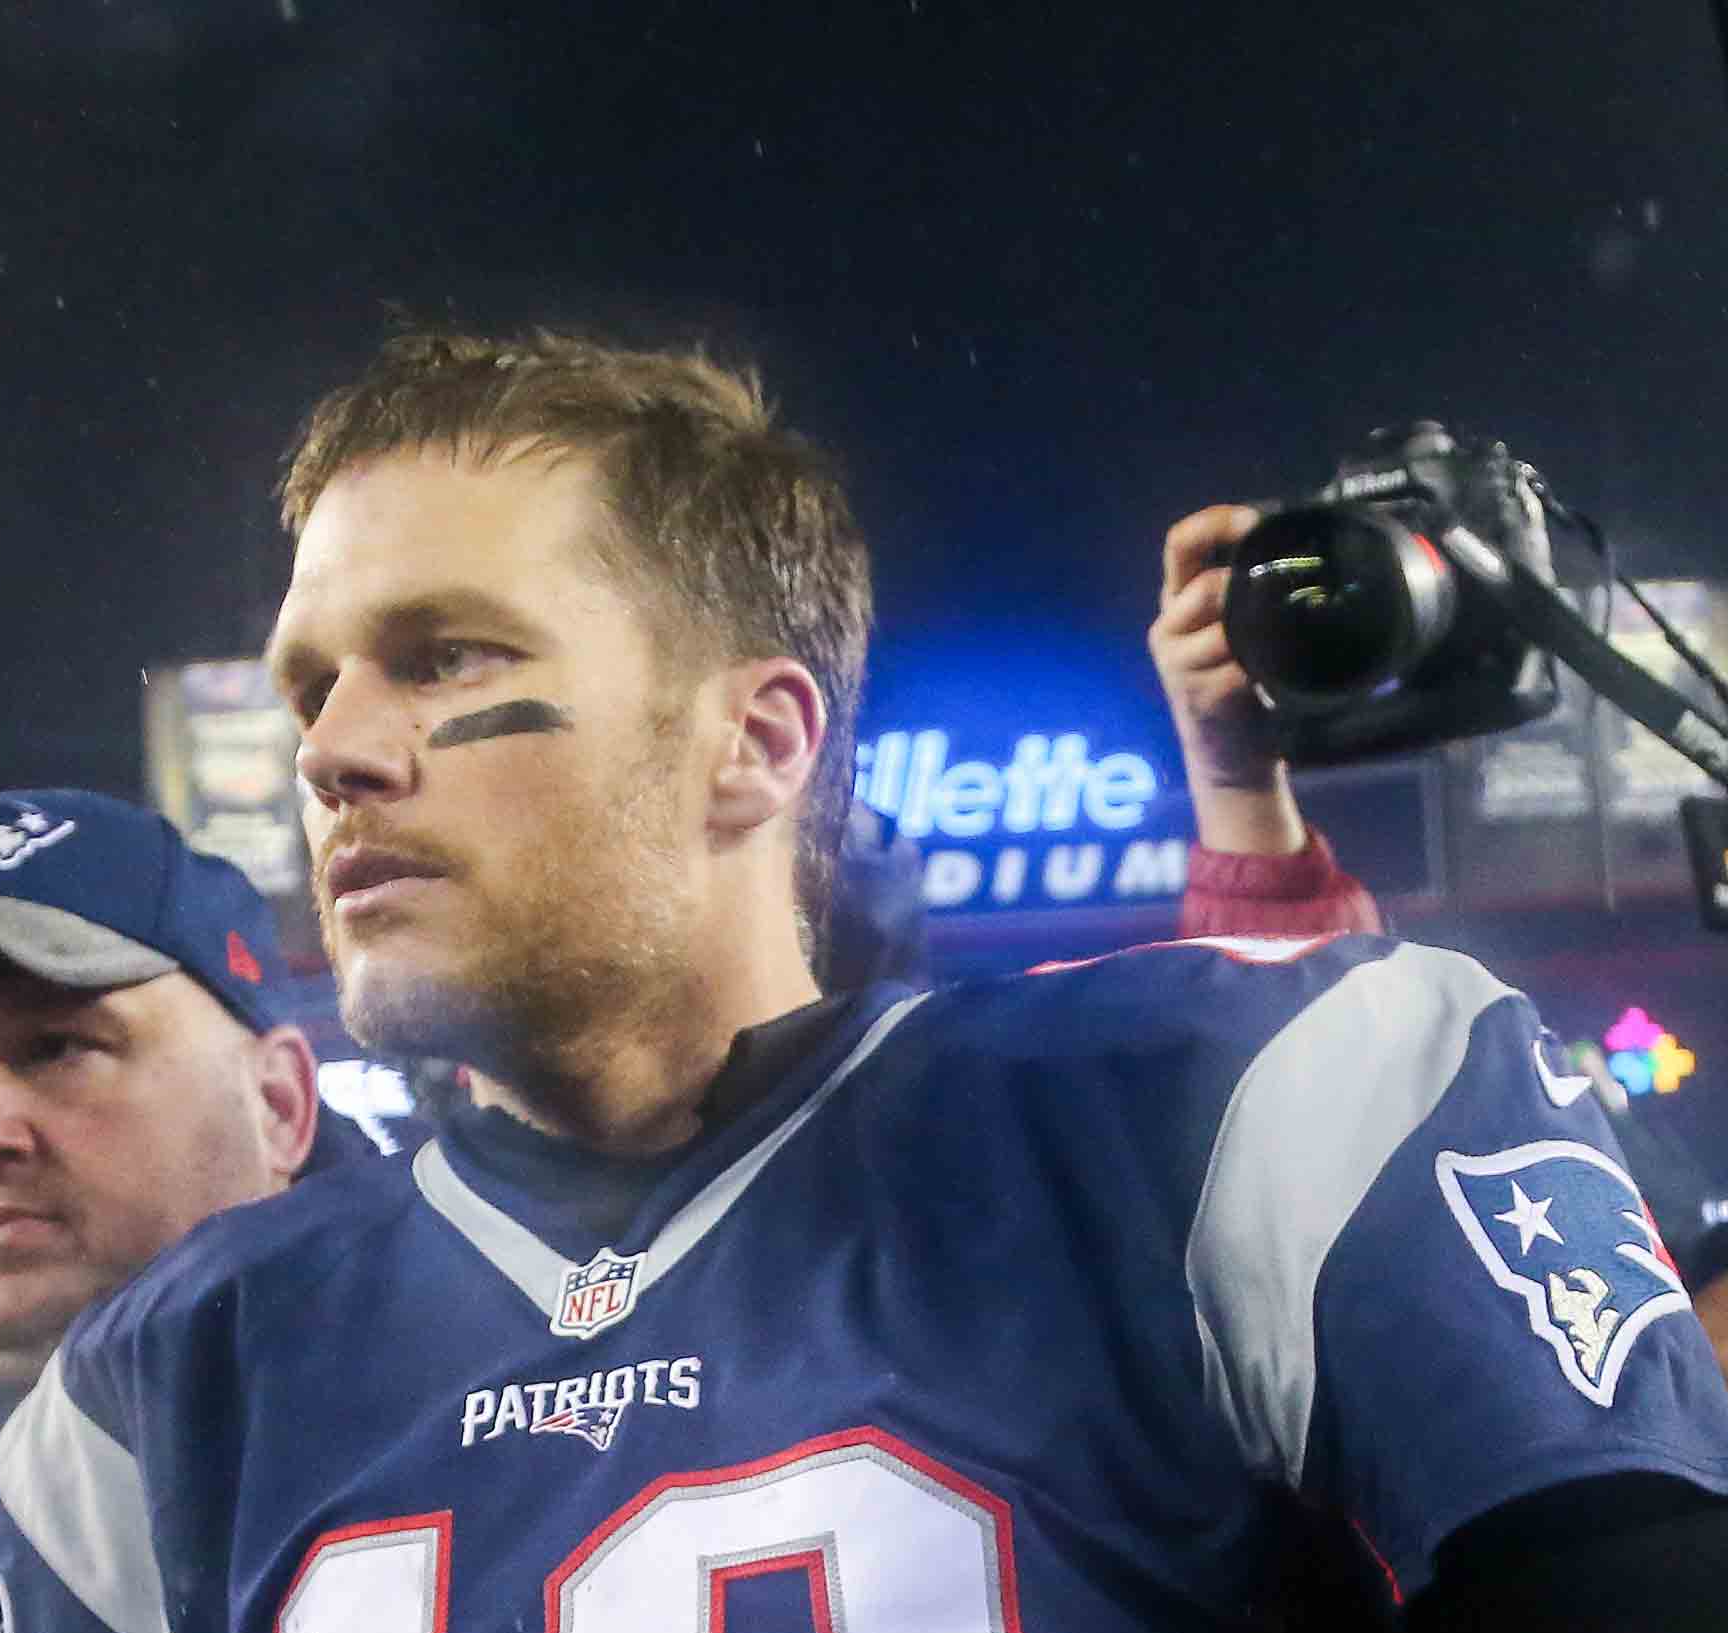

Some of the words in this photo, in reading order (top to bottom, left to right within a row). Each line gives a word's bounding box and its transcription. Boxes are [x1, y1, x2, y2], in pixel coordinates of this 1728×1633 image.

[854, 729, 1157, 838] illette
[922, 838, 1188, 906] DIUM
[564, 1282, 621, 1324] NFL
[460, 1356, 703, 1448] PATRIOTS
